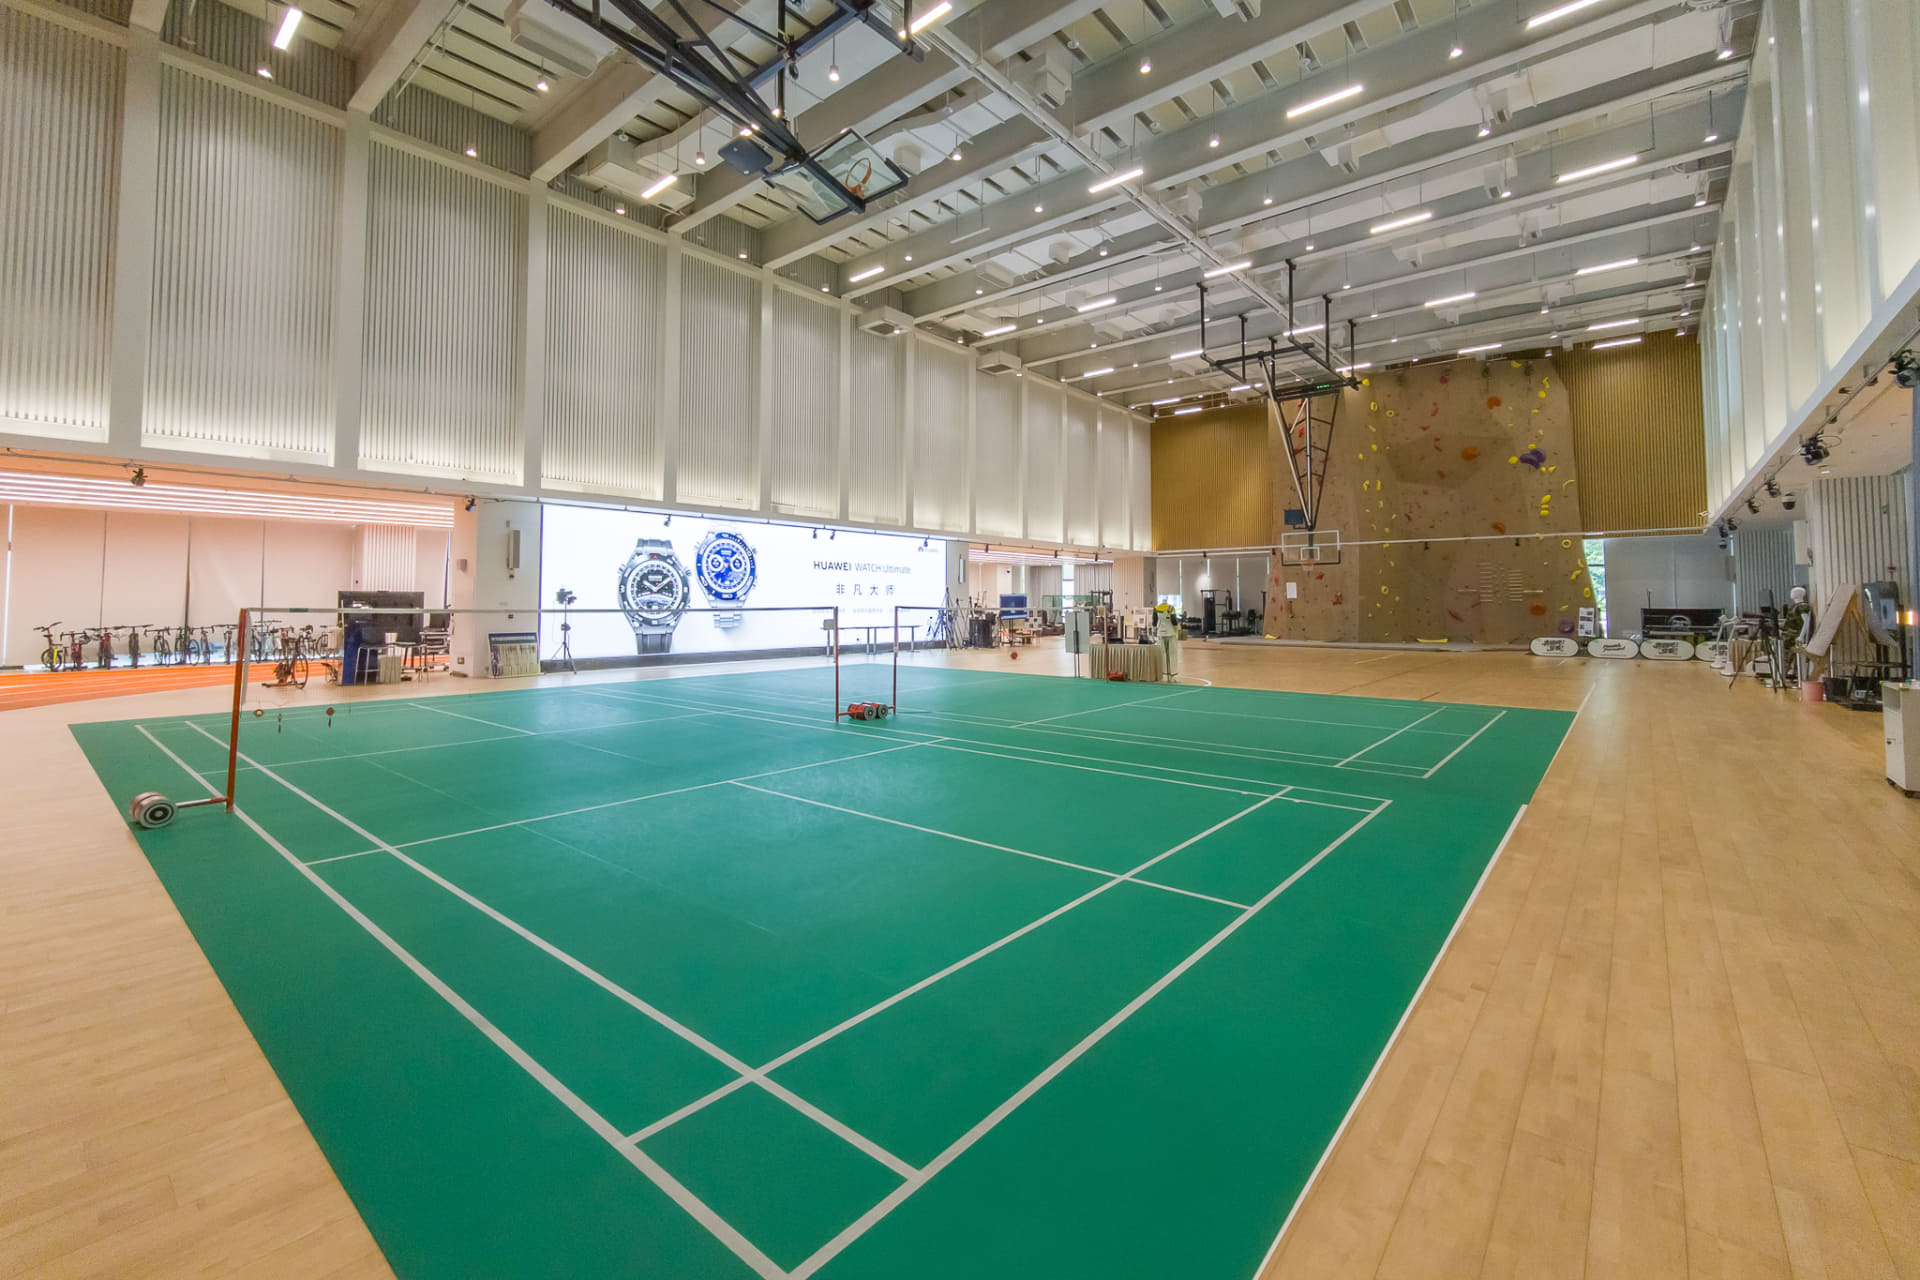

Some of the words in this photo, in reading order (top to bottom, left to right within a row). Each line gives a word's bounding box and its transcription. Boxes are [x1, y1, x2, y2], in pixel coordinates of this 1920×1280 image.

[813, 561, 851, 571] HUAWEI
[855, 562, 881, 573] WATCH
[883, 564, 911, 574] Ultimate
